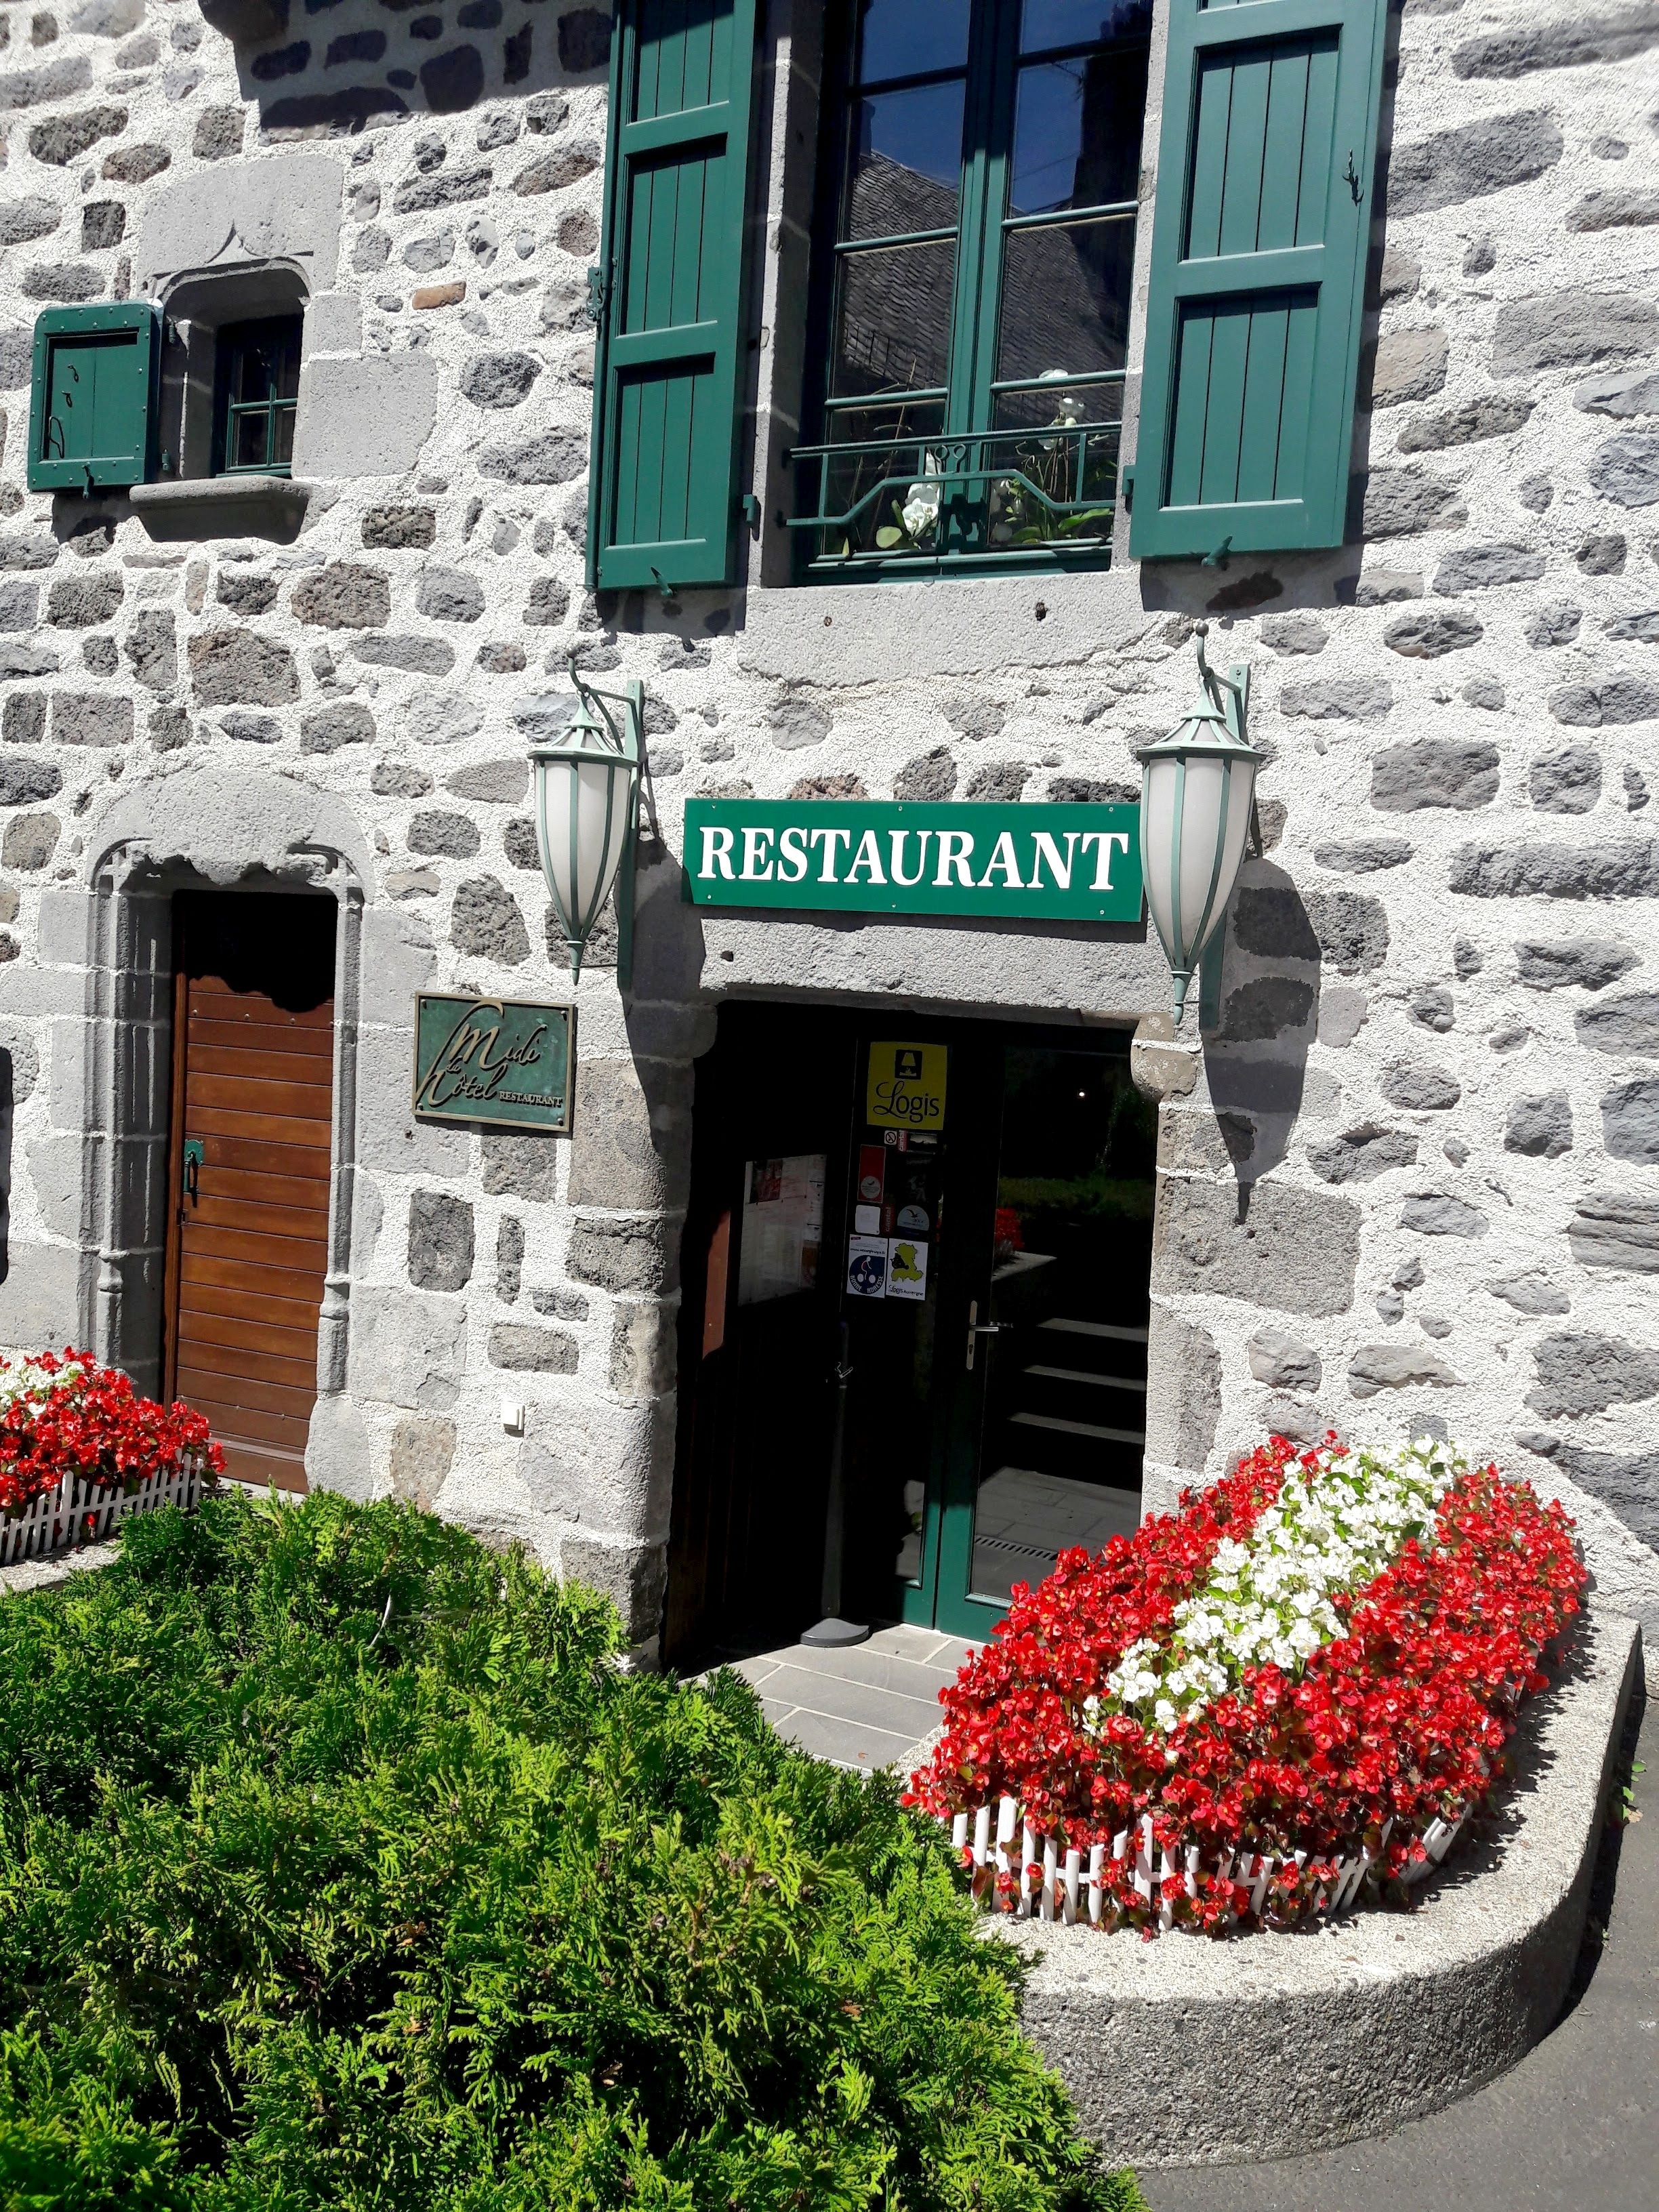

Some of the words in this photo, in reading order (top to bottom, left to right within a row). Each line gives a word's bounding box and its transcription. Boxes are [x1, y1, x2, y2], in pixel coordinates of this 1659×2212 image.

[697, 826, 1129, 890] RESTAURANT
[449, 1023, 548, 1071] Midi
[499, 1090, 563, 1107] RESTAURANT
[872, 1080, 940, 1123] Logis
